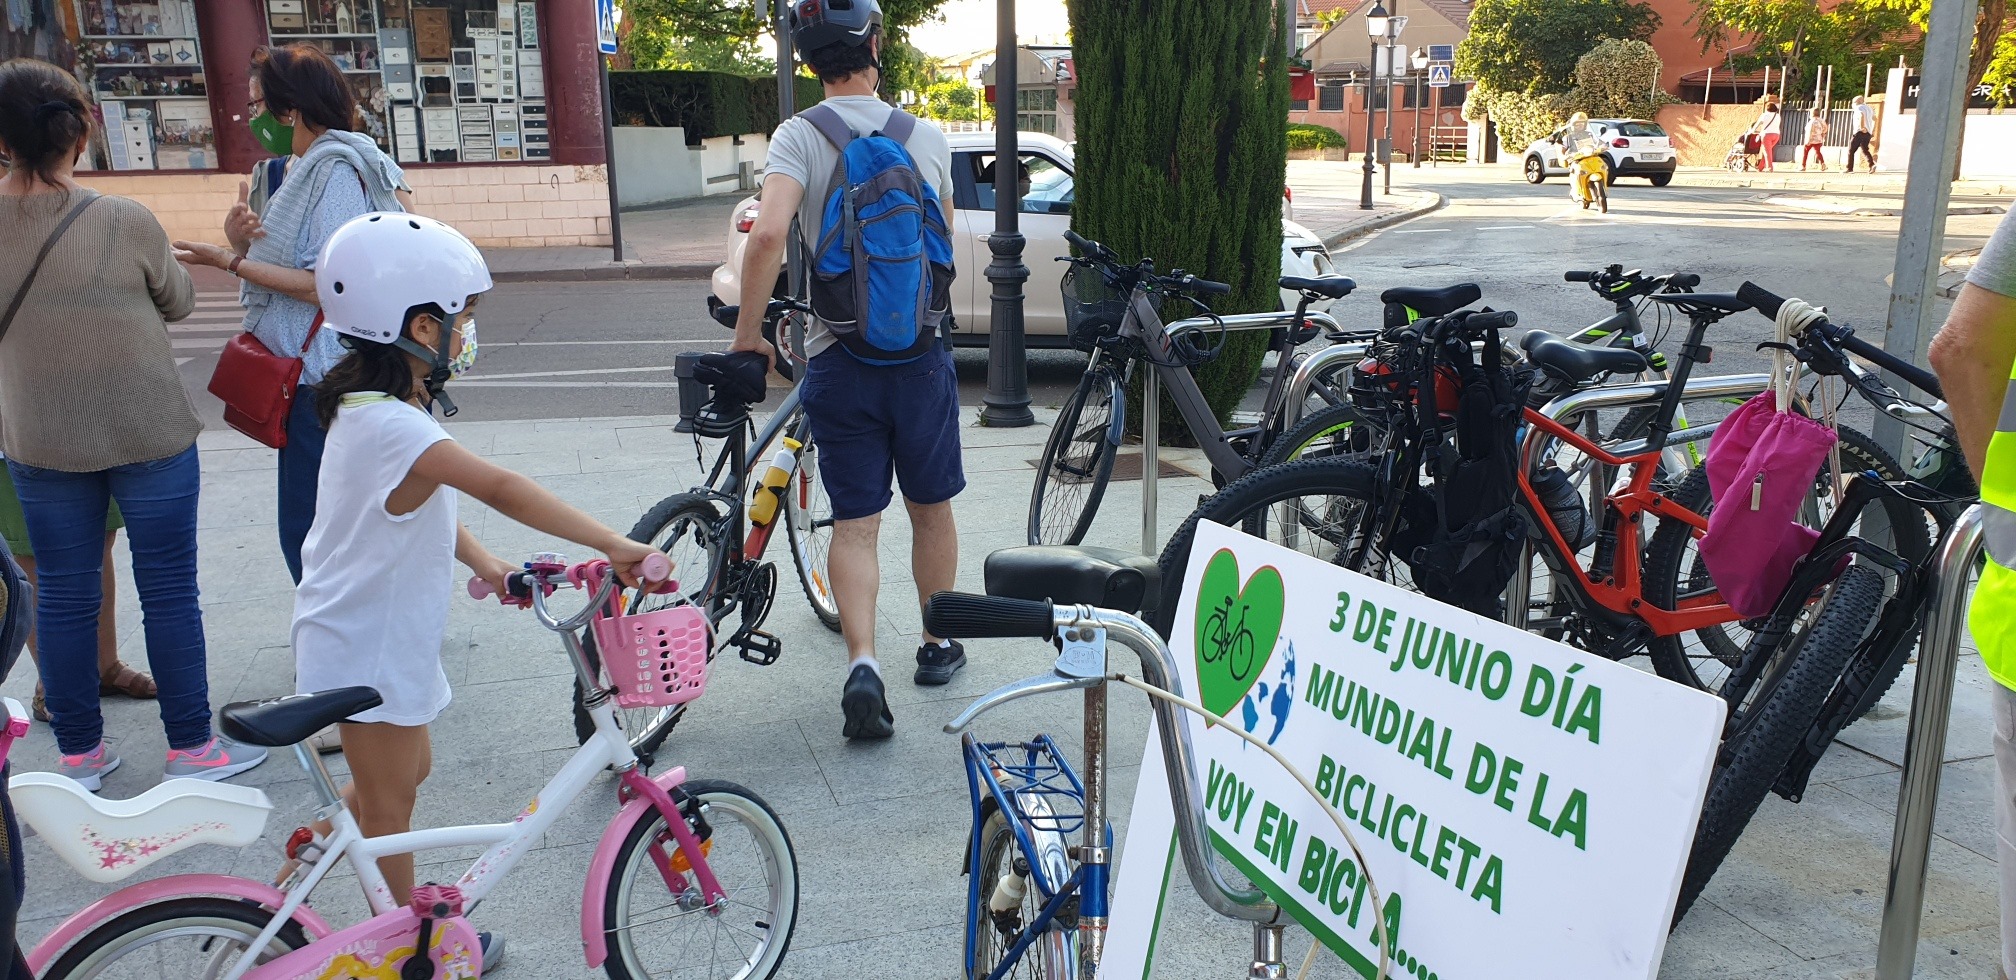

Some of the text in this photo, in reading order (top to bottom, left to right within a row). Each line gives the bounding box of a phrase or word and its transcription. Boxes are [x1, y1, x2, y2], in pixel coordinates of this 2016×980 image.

[1838, 440, 1894, 480] MAXXIS
[1329, 591, 1602, 745] 3 DE JUNIO DÍA
[1304, 662, 1588, 851] MUNDIAL DE LA
[1314, 753, 1503, 915] BICLICLETA
[1205, 757, 1255, 835] VOY
[1254, 800, 1299, 874] EN
[1298, 835, 1368, 929] BICI
